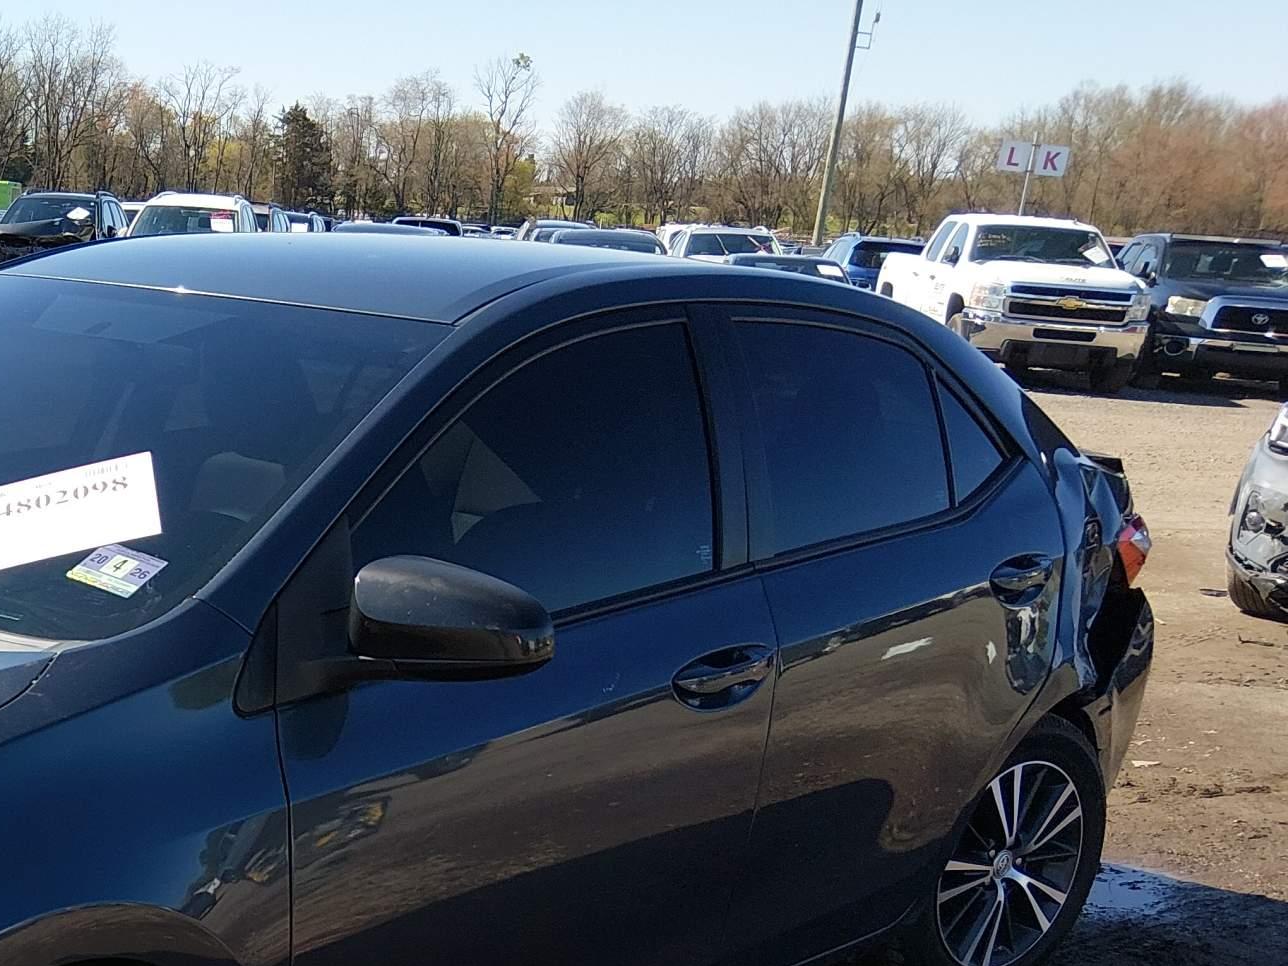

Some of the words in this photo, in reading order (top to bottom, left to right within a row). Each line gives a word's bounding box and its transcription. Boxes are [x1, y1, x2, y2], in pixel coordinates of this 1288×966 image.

[1007, 147, 1019, 166] L
[1043, 151, 1061, 171] K
[90, 553, 109, 564] 20
[112, 558, 129, 573] 4
[129, 567, 150, 580] 26
